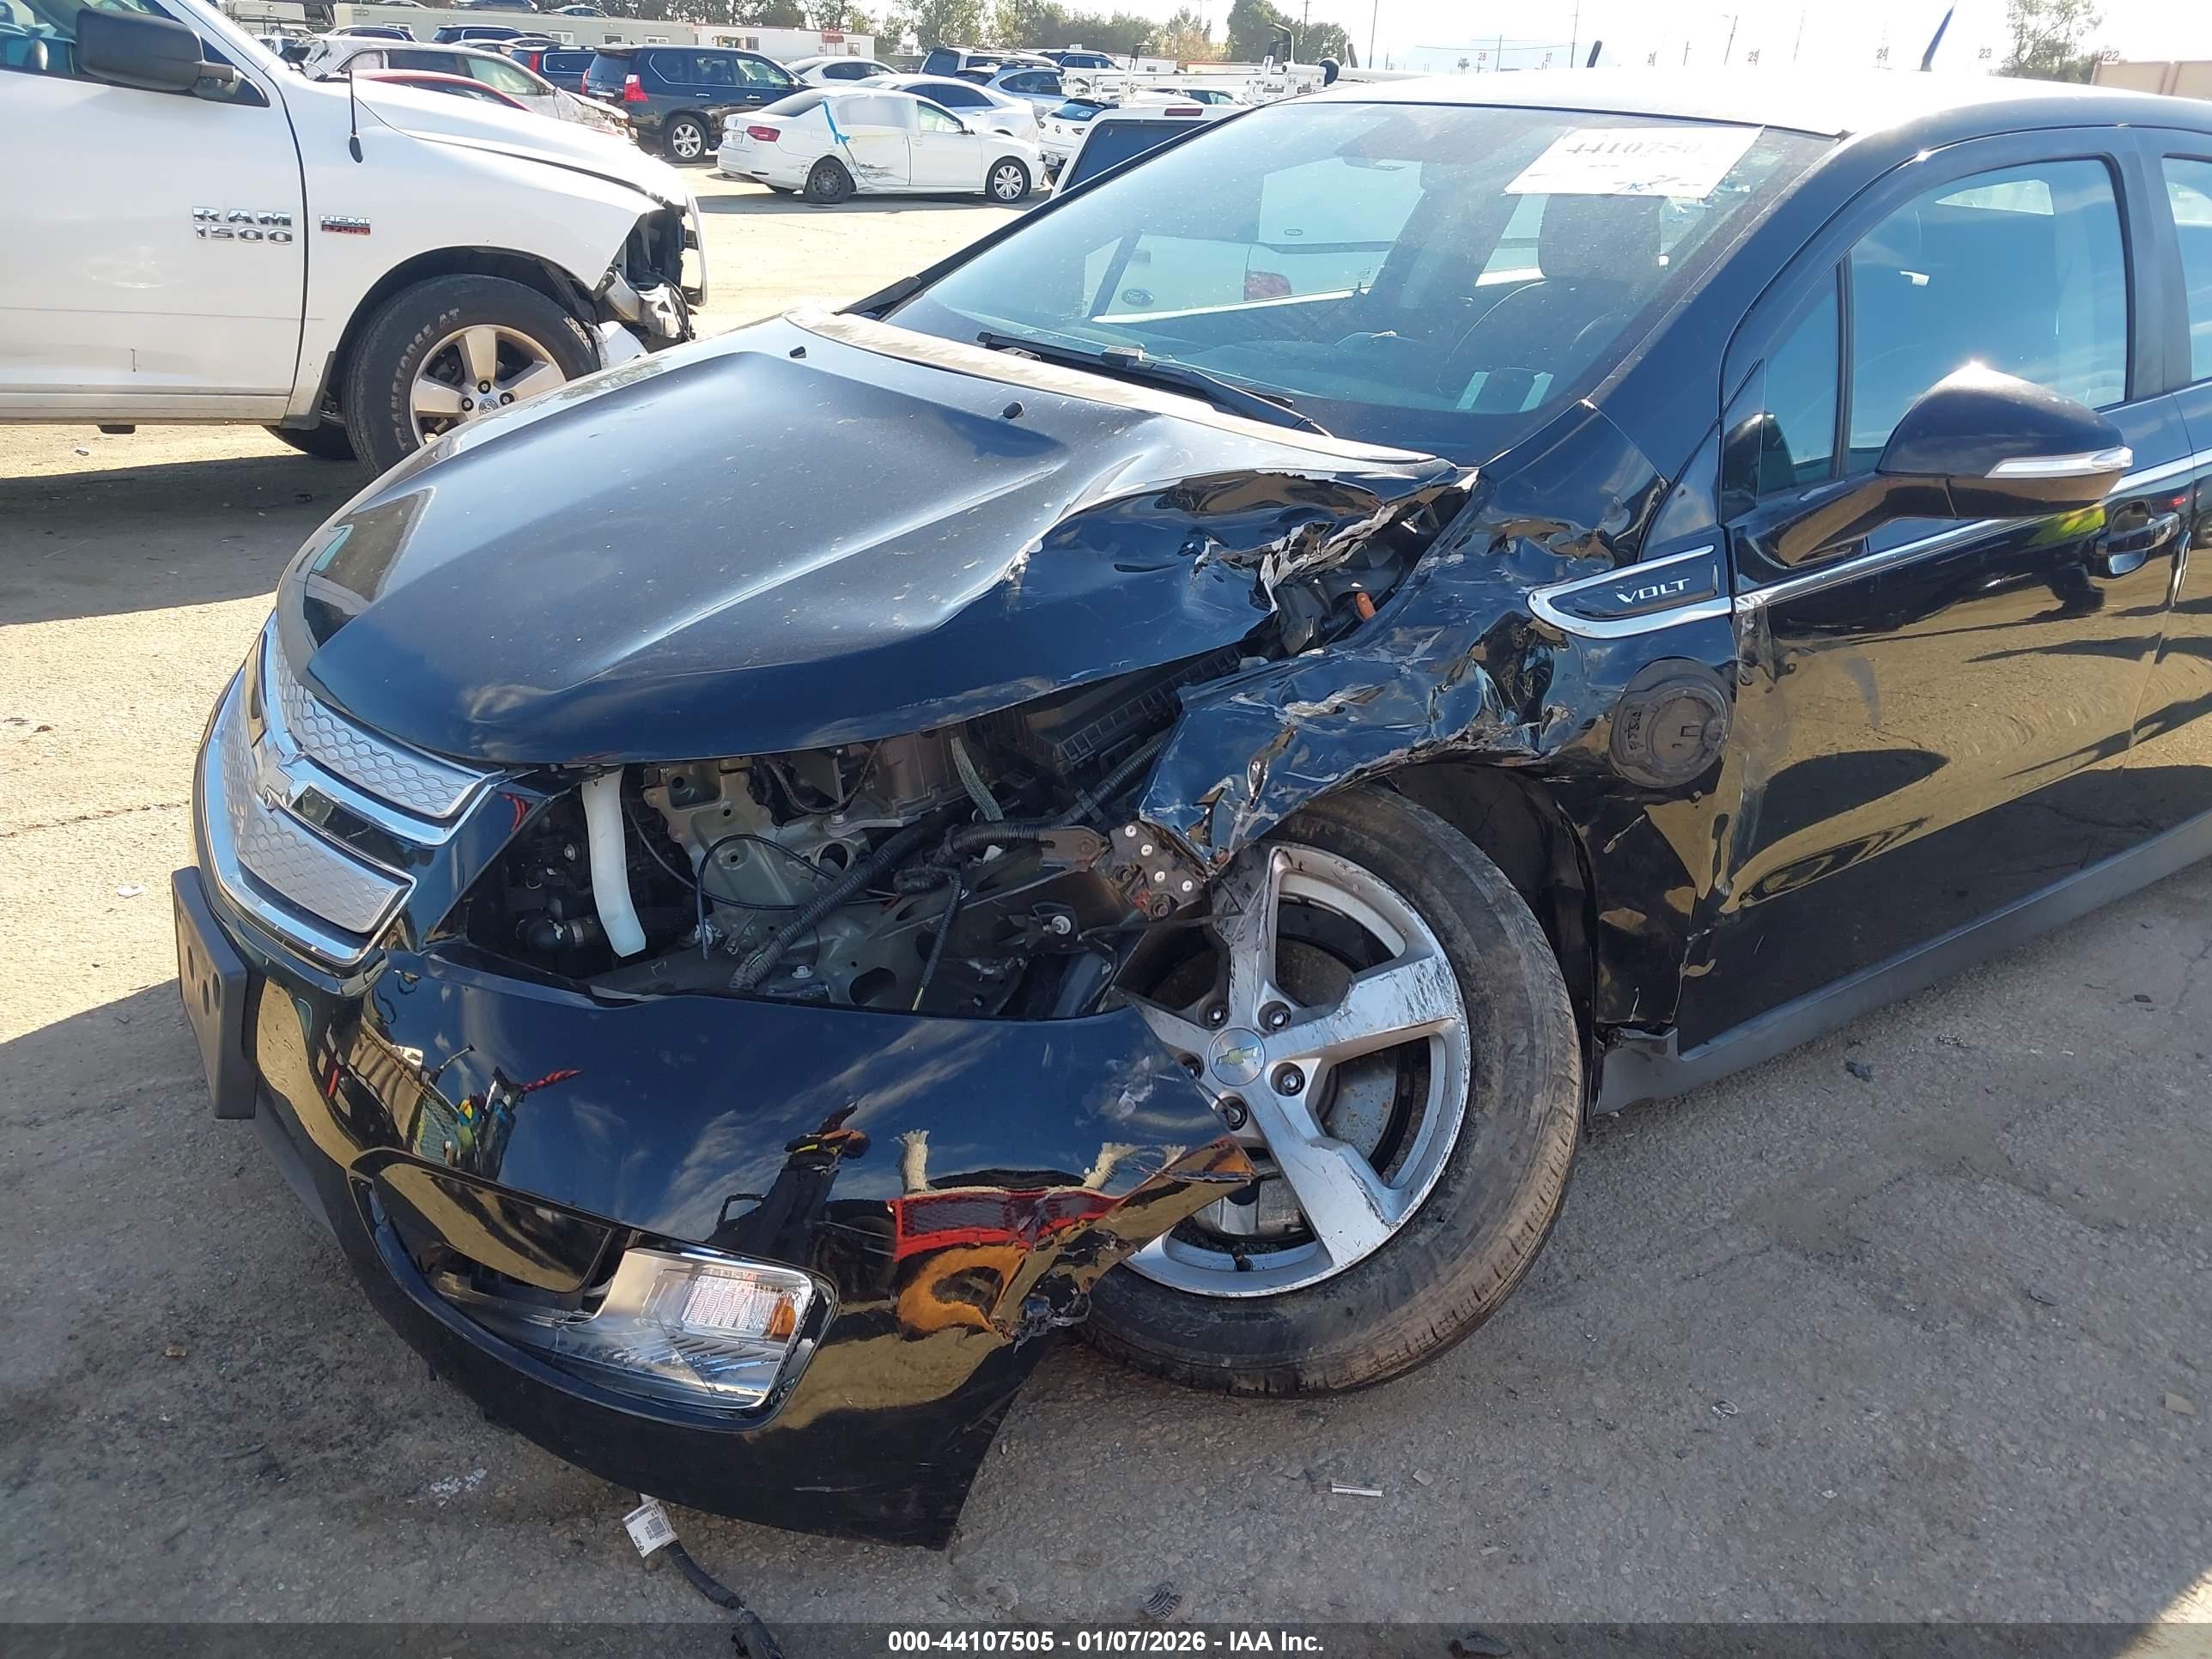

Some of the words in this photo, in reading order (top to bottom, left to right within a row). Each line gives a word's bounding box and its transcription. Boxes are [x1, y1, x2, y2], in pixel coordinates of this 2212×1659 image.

[1478, 52, 1486, 61] 28
[1876, 48, 1889, 60] 24
[1978, 48, 1992, 59] 23
[2104, 51, 2120, 62] 22
[192, 206, 293, 228] RAM
[319, 215, 371, 227] HEMI
[193, 224, 294, 245] 1500
[1615, 578, 1691, 605] VOLT
